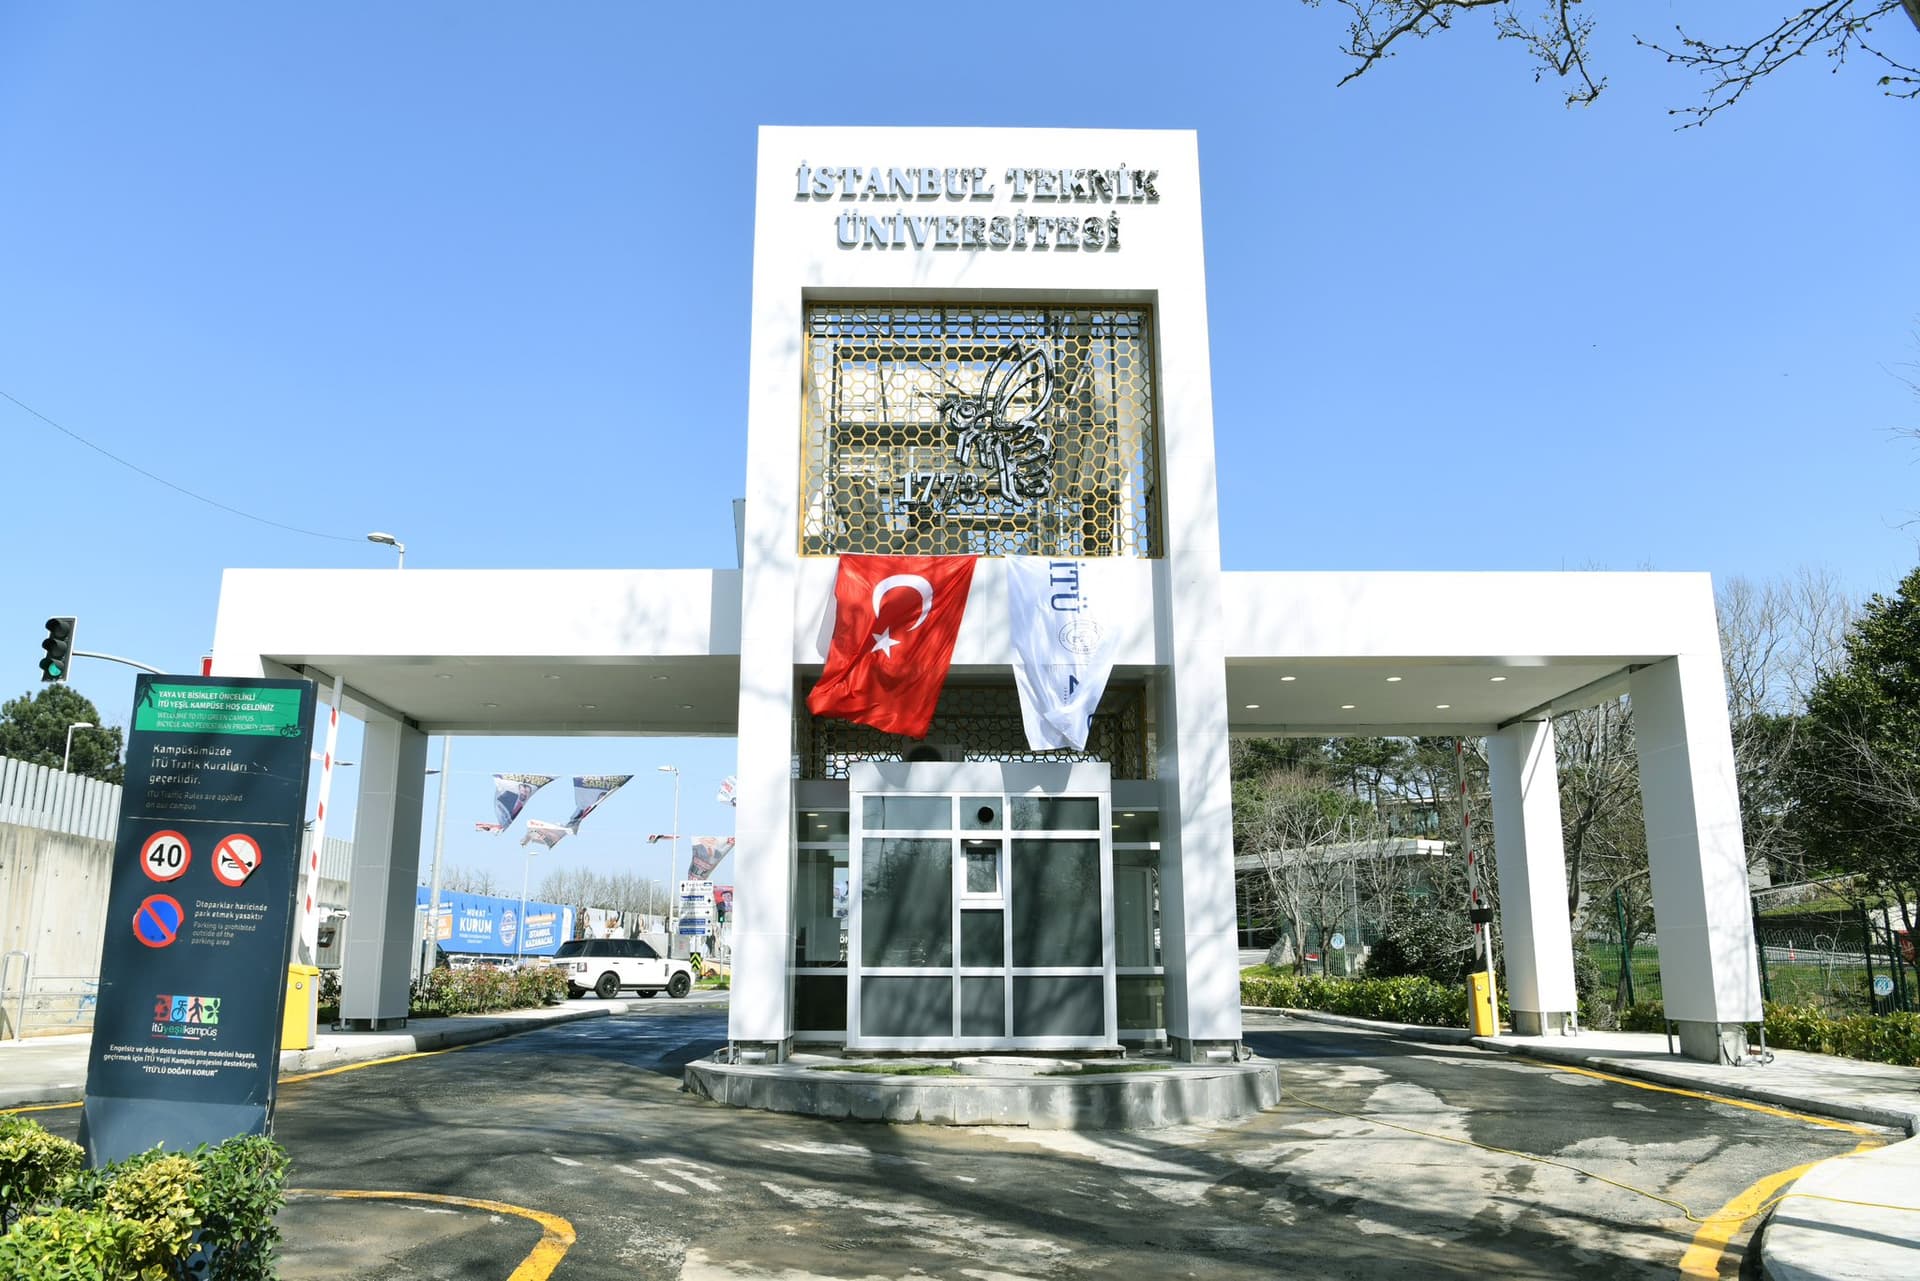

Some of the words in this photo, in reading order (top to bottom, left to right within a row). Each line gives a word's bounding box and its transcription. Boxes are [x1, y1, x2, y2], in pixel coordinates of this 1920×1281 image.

[795, 160, 996, 202] İSTANBUL
[1005, 162, 1161, 204] TEKNİK
[835, 208, 1122, 252] ÜNİVERSİTESİ
[898, 471, 980, 506] 1773
[1049, 560, 1089, 614] İTÜ
[159, 690, 177, 699] YAYA
[177, 691, 187, 699] VE
[158, 699, 169, 708] İTÜ
[170, 700, 189, 710] YEŞİL
[190, 701, 225, 710] KAMPÜSE
[225, 702, 240, 712] HOŞ
[241, 703, 275, 712] GELDİNİZ
[153, 744, 232, 757] Kampüsümüzde
[151, 756, 169, 768] İTÜ
[172, 759, 200, 769] Trafik
[203, 760, 248, 772] Kuralları
[149, 843, 183, 868] 40
[195, 900, 234, 910] Otoparklar
[234, 901, 268, 912] haricinde
[194, 910, 211, 918] park
[211, 911, 234, 919] etmek
[234, 912, 264, 921] yasaktır
[459, 917, 493, 933] KURUM
[109, 1044, 135, 1053] Engelsiz
[143, 1045, 159, 1055] doğa
[159, 1047, 176, 1055] dostu
[177, 1048, 208, 1056] üniversite
[208, 1049, 234, 1058] modelini
[234, 1050, 256, 1060] hayata
[103, 1053, 132, 1063] geçirmek
[132, 1054, 143, 1064] için
[144, 1054, 154, 1063] İTÜ
[154, 1056, 170, 1065] Yeşil
[171, 1057, 195, 1066] Kampüs
[195, 1058, 222, 1068] projesini
[167, 1066, 192, 1076] DOĞAYI
